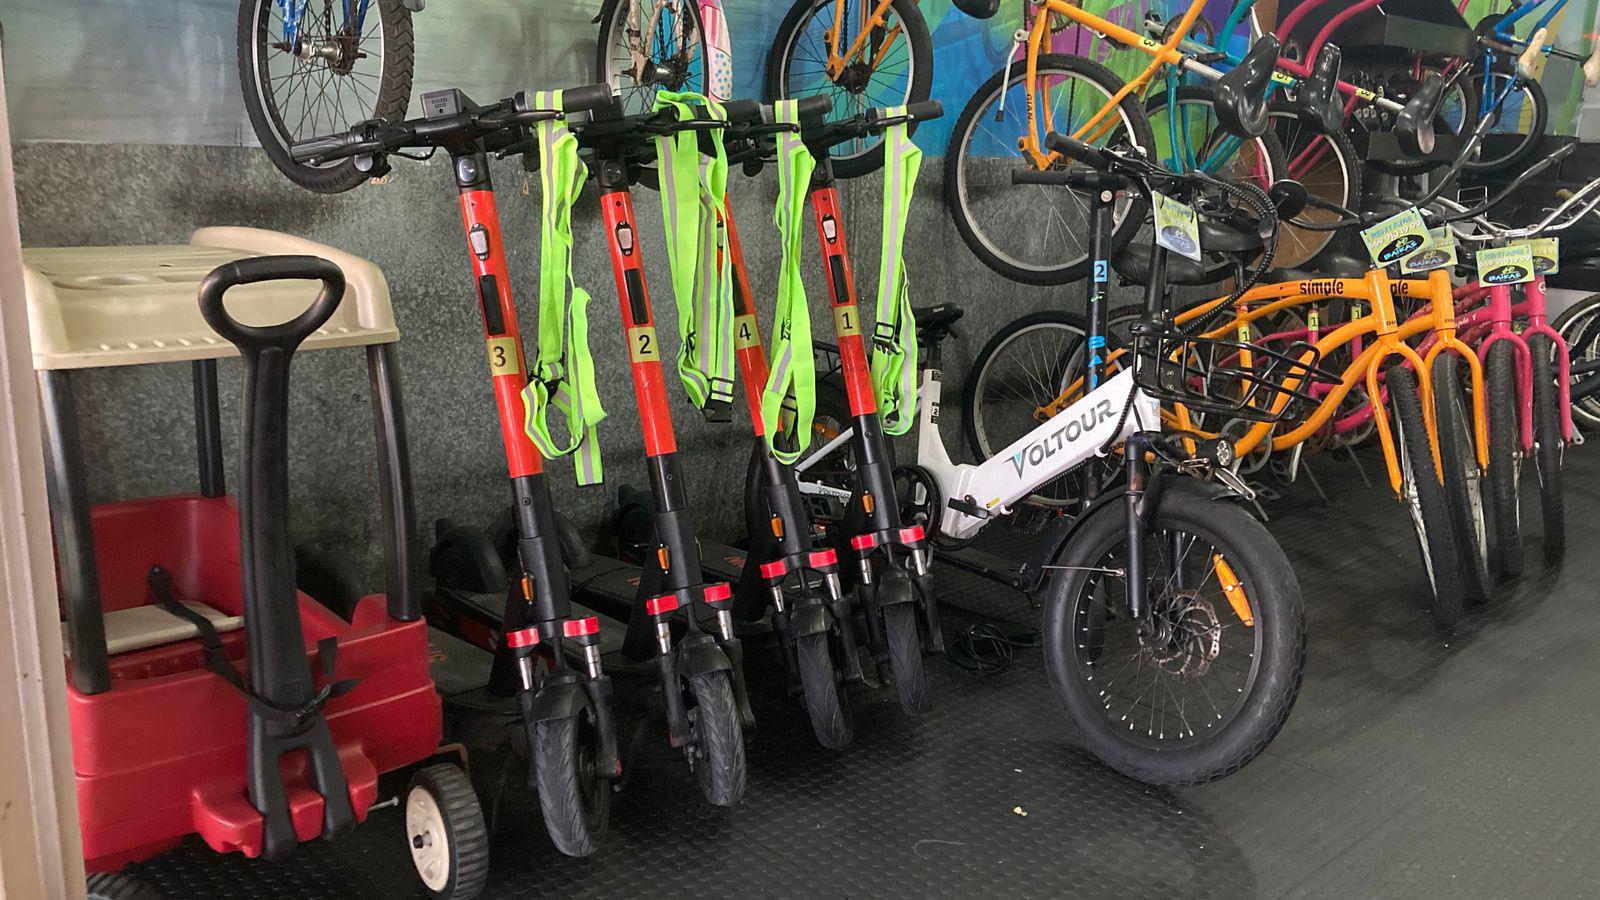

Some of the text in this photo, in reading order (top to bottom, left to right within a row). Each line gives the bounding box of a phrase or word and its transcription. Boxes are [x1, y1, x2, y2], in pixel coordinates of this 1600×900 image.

[1143, 38, 1156, 47] 3
[1383, 240, 1417, 260] BAIKAS
[1095, 264, 1105, 278] 2
[1488, 272, 1521, 281] BAIKAS
[1300, 279, 1344, 296] simple
[1390, 281, 1409, 296] ple
[842, 312, 853, 330] 1
[1311, 317, 1318, 327] 1
[739, 322, 751, 341] 4
[638, 334, 652, 355] 2
[492, 345, 507, 368] 3
[1002, 399, 1119, 480] VOLTOUR
